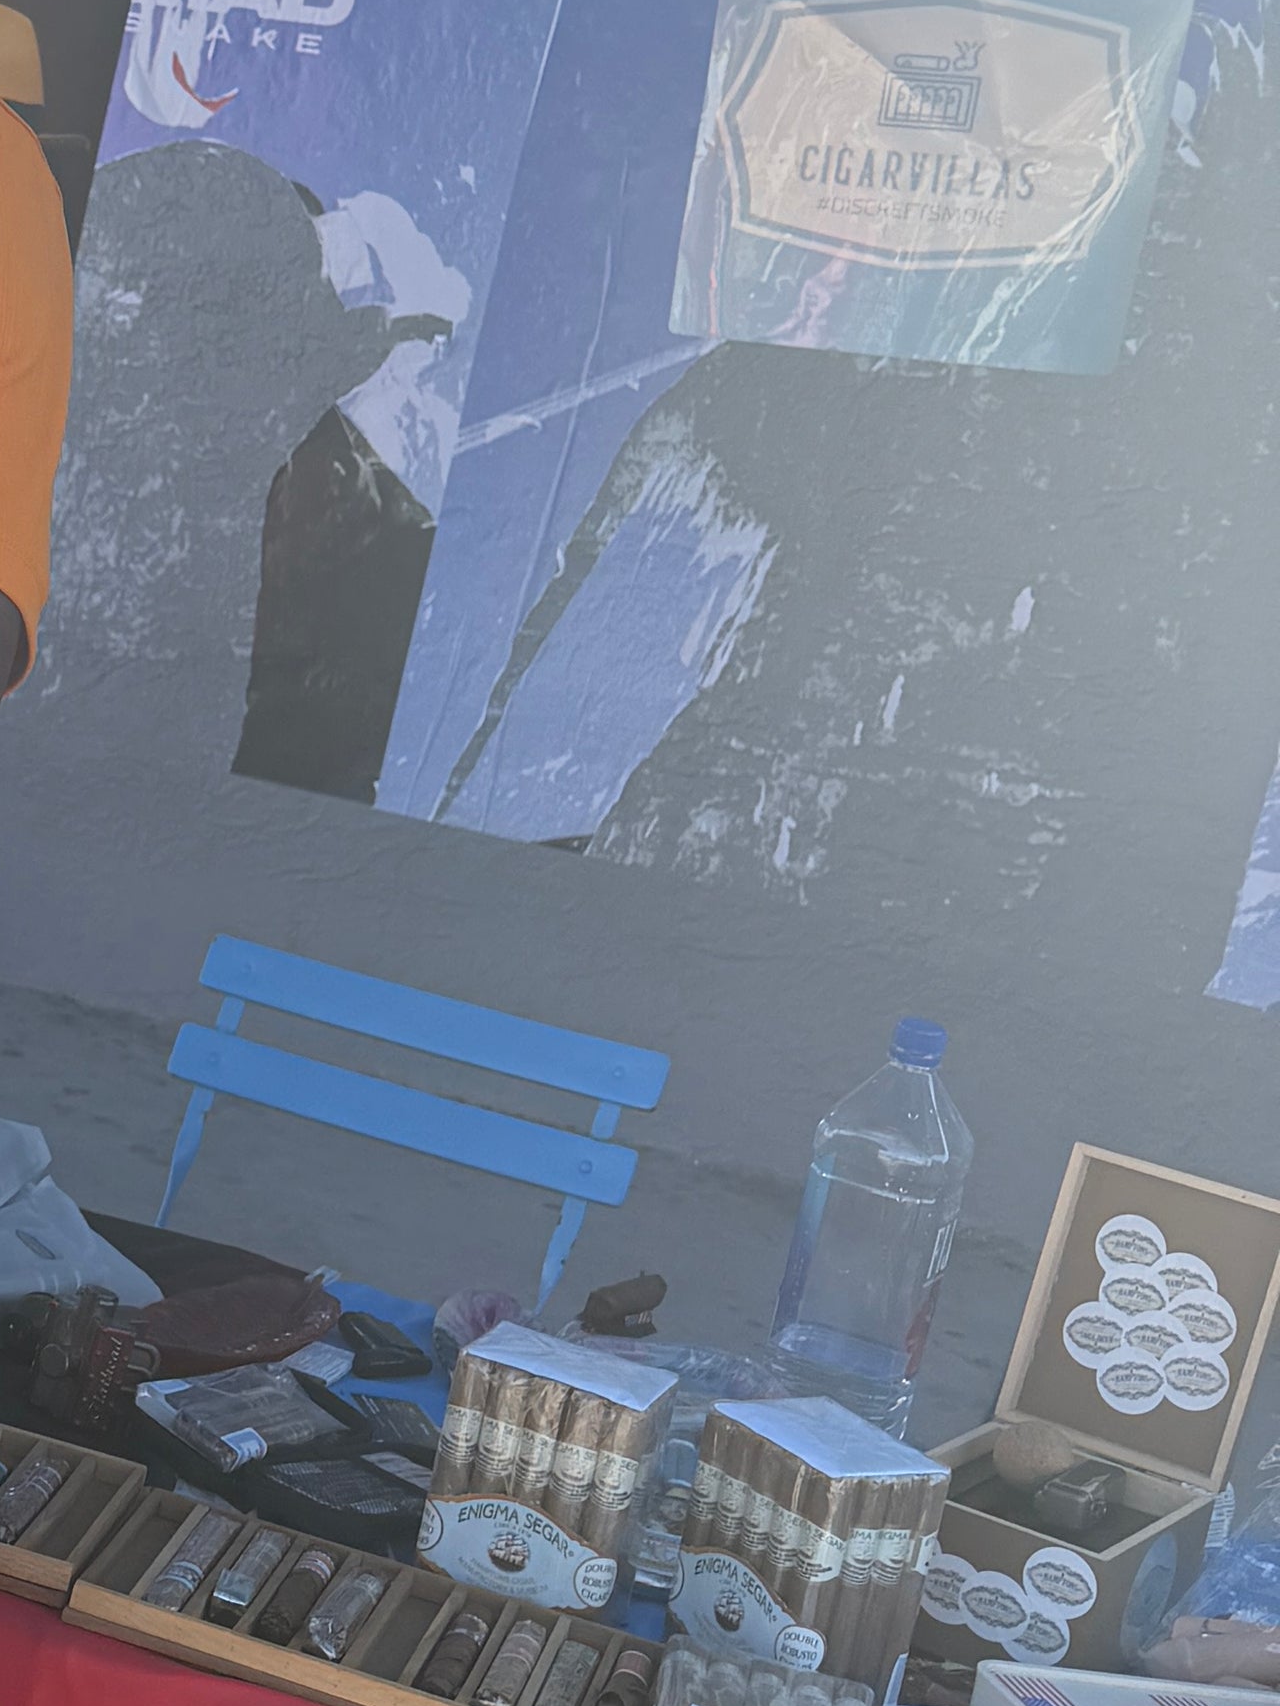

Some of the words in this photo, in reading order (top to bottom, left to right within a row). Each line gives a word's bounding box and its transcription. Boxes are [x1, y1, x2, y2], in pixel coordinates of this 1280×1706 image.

[798, 143, 1037, 201] CIGARVILLAS
[457, 1503, 519, 1524] ENIGMA
[694, 1557, 738, 1583] ENIGMA
